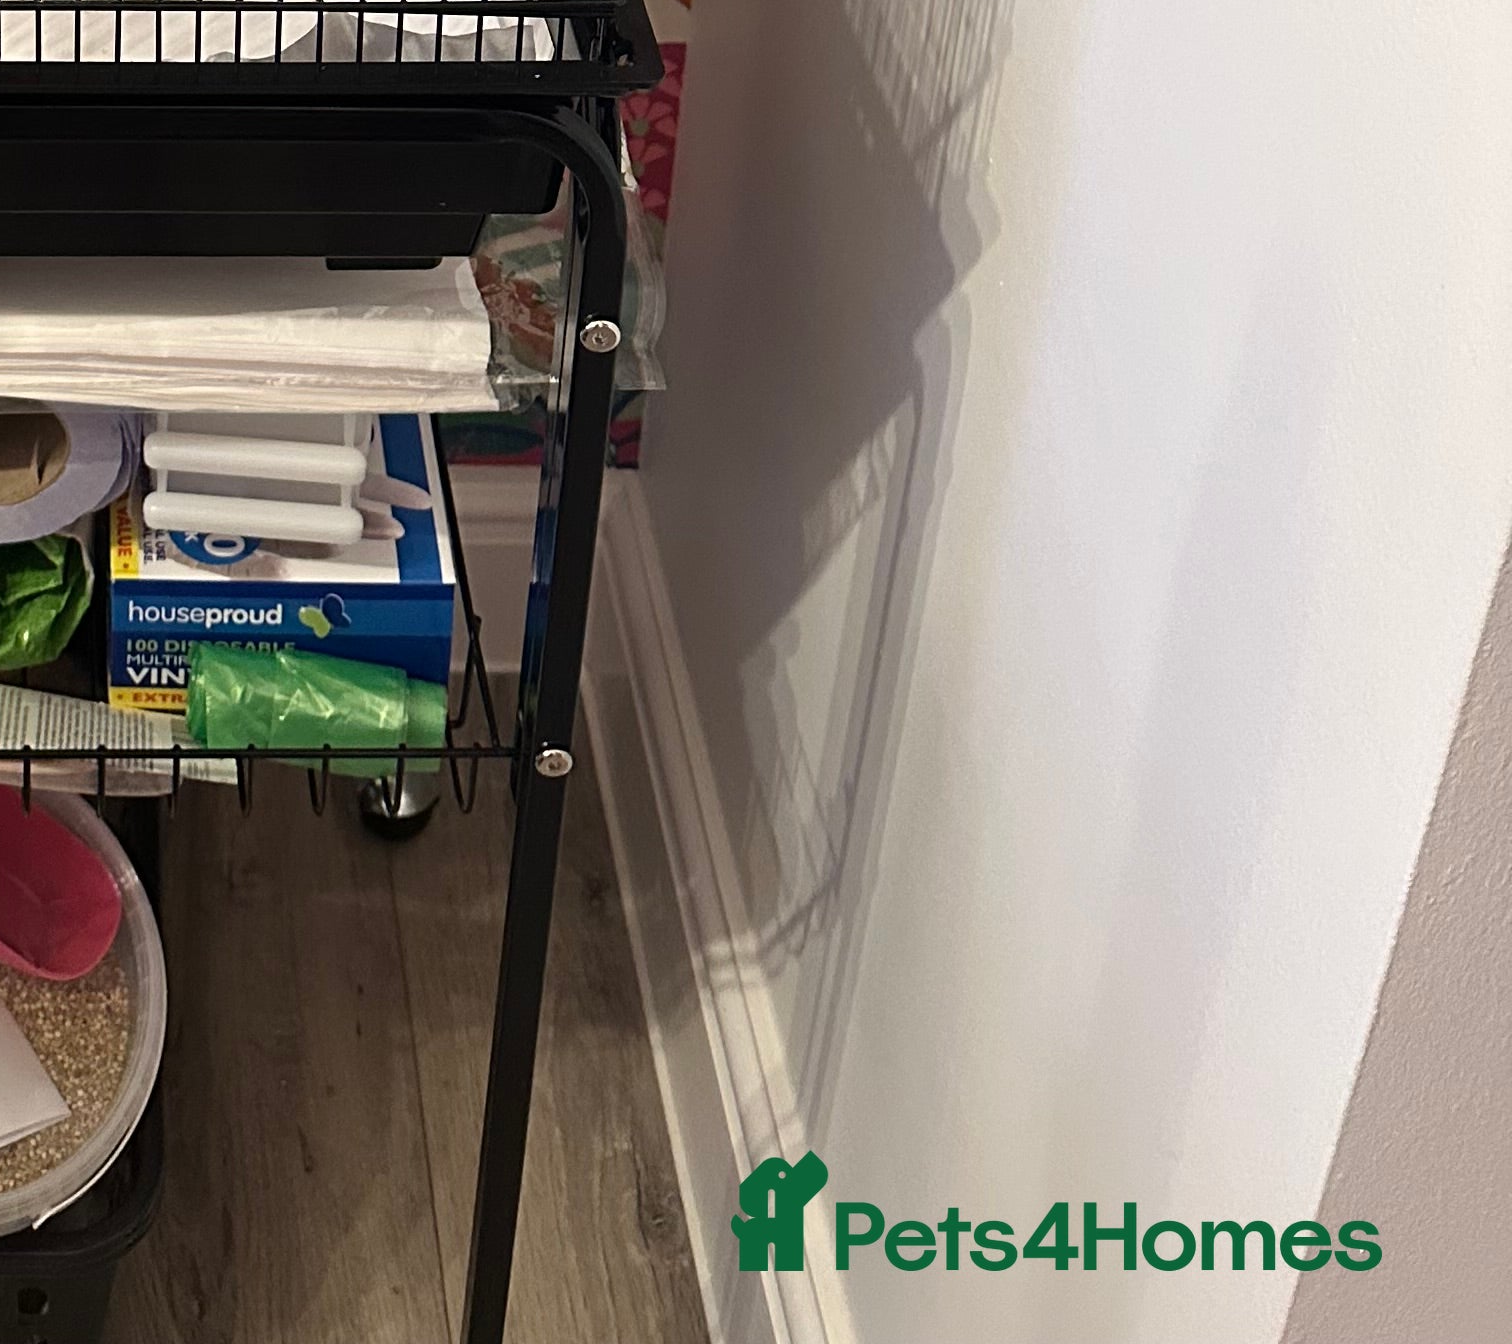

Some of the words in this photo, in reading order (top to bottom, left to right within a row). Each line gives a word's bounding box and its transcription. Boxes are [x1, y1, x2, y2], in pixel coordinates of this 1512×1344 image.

[116, 507, 133, 557] VALUE
[128, 600, 283, 629] houseproud
[126, 638, 159, 652] 100
[126, 667, 192, 685] VIN
[132, 692, 186, 703] EXTR
